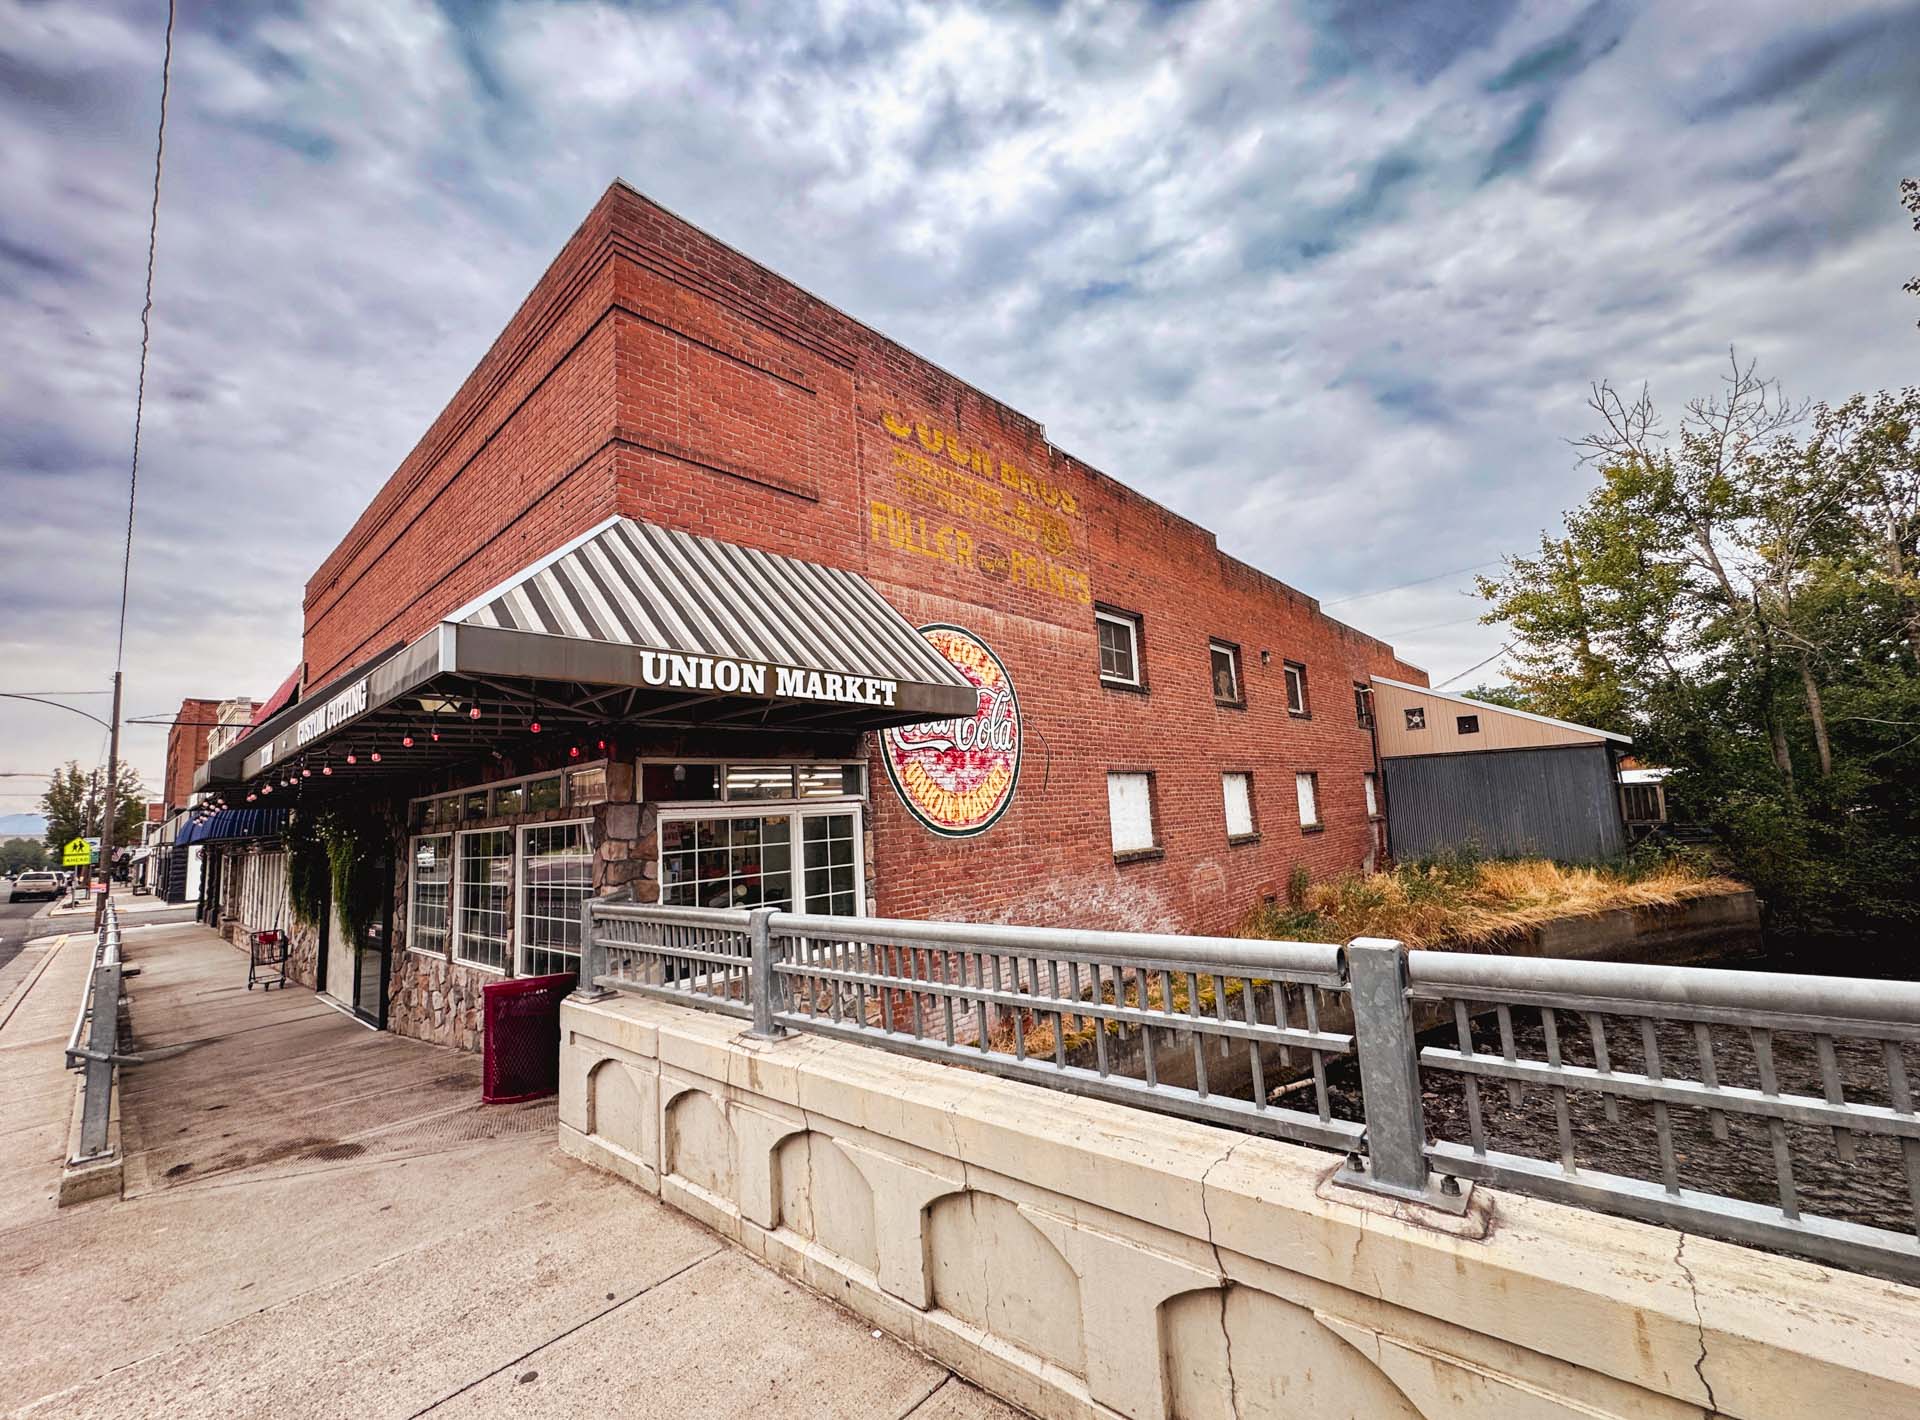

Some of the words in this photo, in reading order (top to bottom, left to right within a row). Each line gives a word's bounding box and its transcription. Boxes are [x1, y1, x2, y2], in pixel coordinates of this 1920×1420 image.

[870, 500, 974, 568] FULLER
[327, 679, 368, 729] CUTTING
[639, 651, 766, 695] UNION
[775, 667, 897, 706] MARKET
[903, 760, 956, 820] UNION
[957, 763, 1010, 820] MARKET
